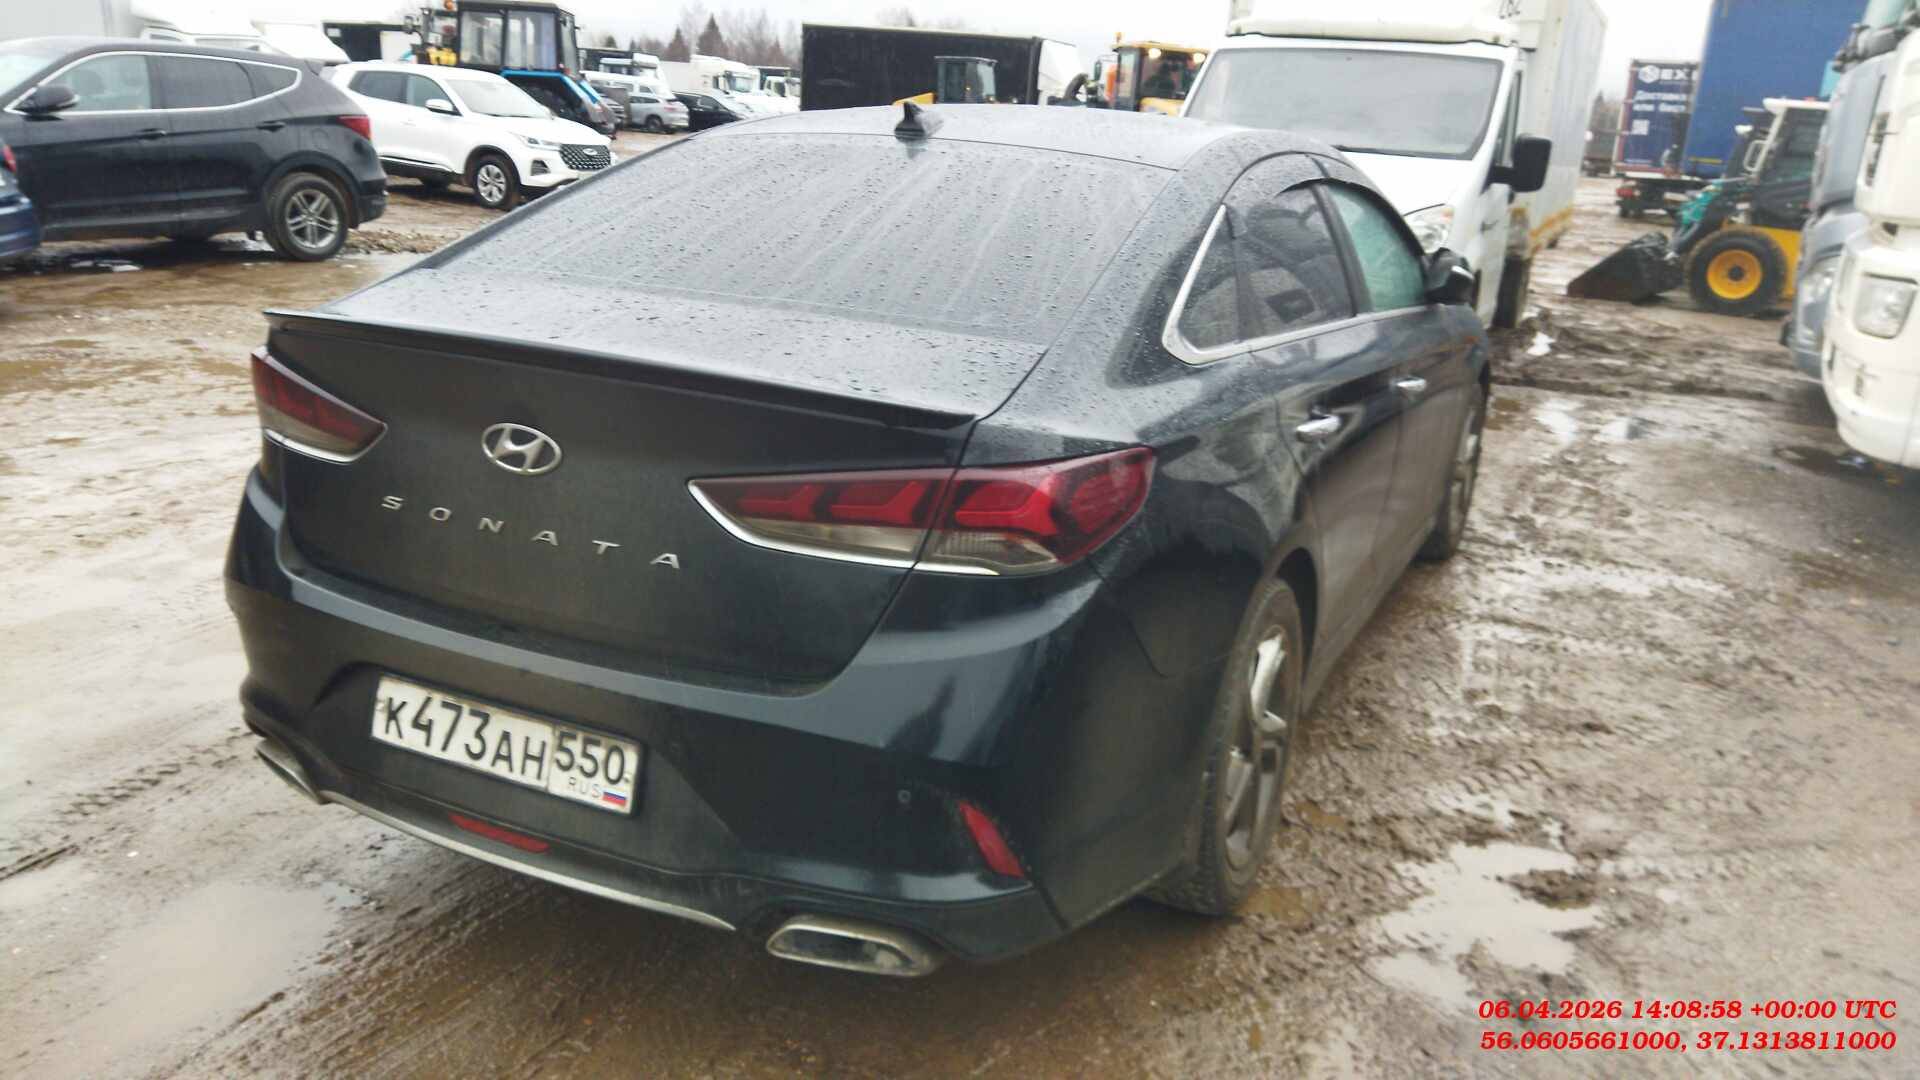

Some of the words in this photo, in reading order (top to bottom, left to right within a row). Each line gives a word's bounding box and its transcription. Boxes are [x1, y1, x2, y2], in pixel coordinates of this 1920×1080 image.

[381, 495, 680, 568] SONATA
[555, 730, 626, 785] 550
[568, 776, 601, 799] RUS
